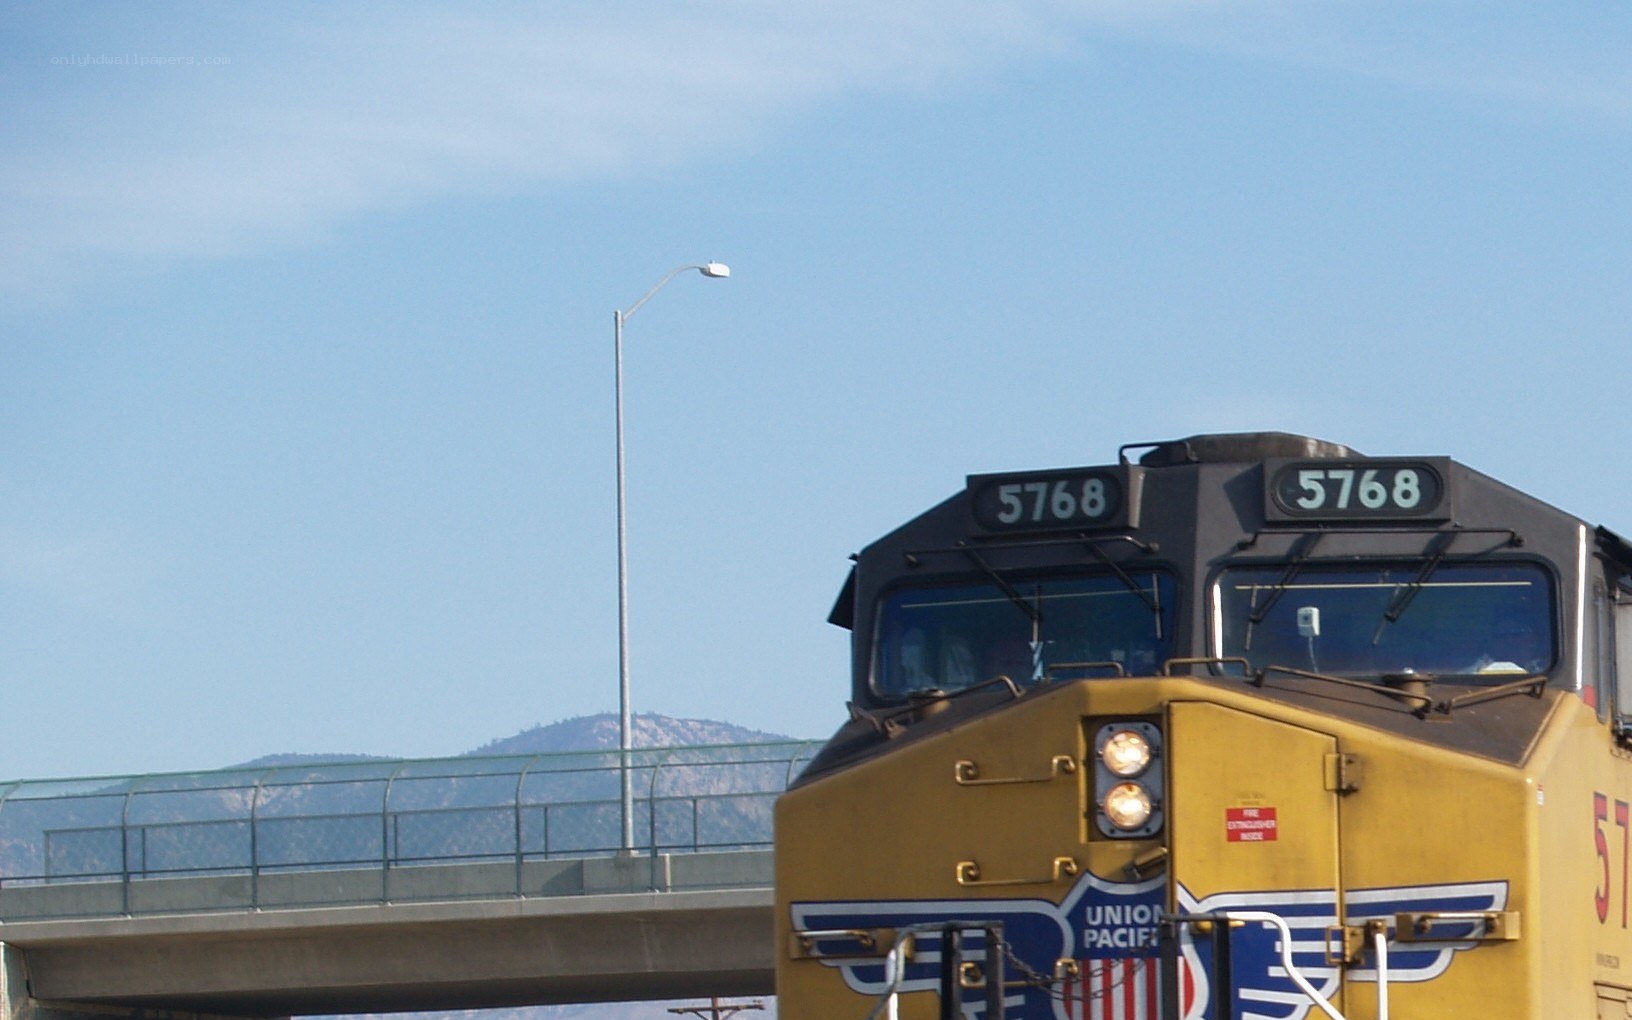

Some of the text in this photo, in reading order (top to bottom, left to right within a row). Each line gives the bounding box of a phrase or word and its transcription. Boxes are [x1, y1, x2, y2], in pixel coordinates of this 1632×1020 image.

[996, 478, 1106, 524] 5768
[1297, 468, 1422, 510] 5768
[1083, 927, 1160, 949] PACIFI
